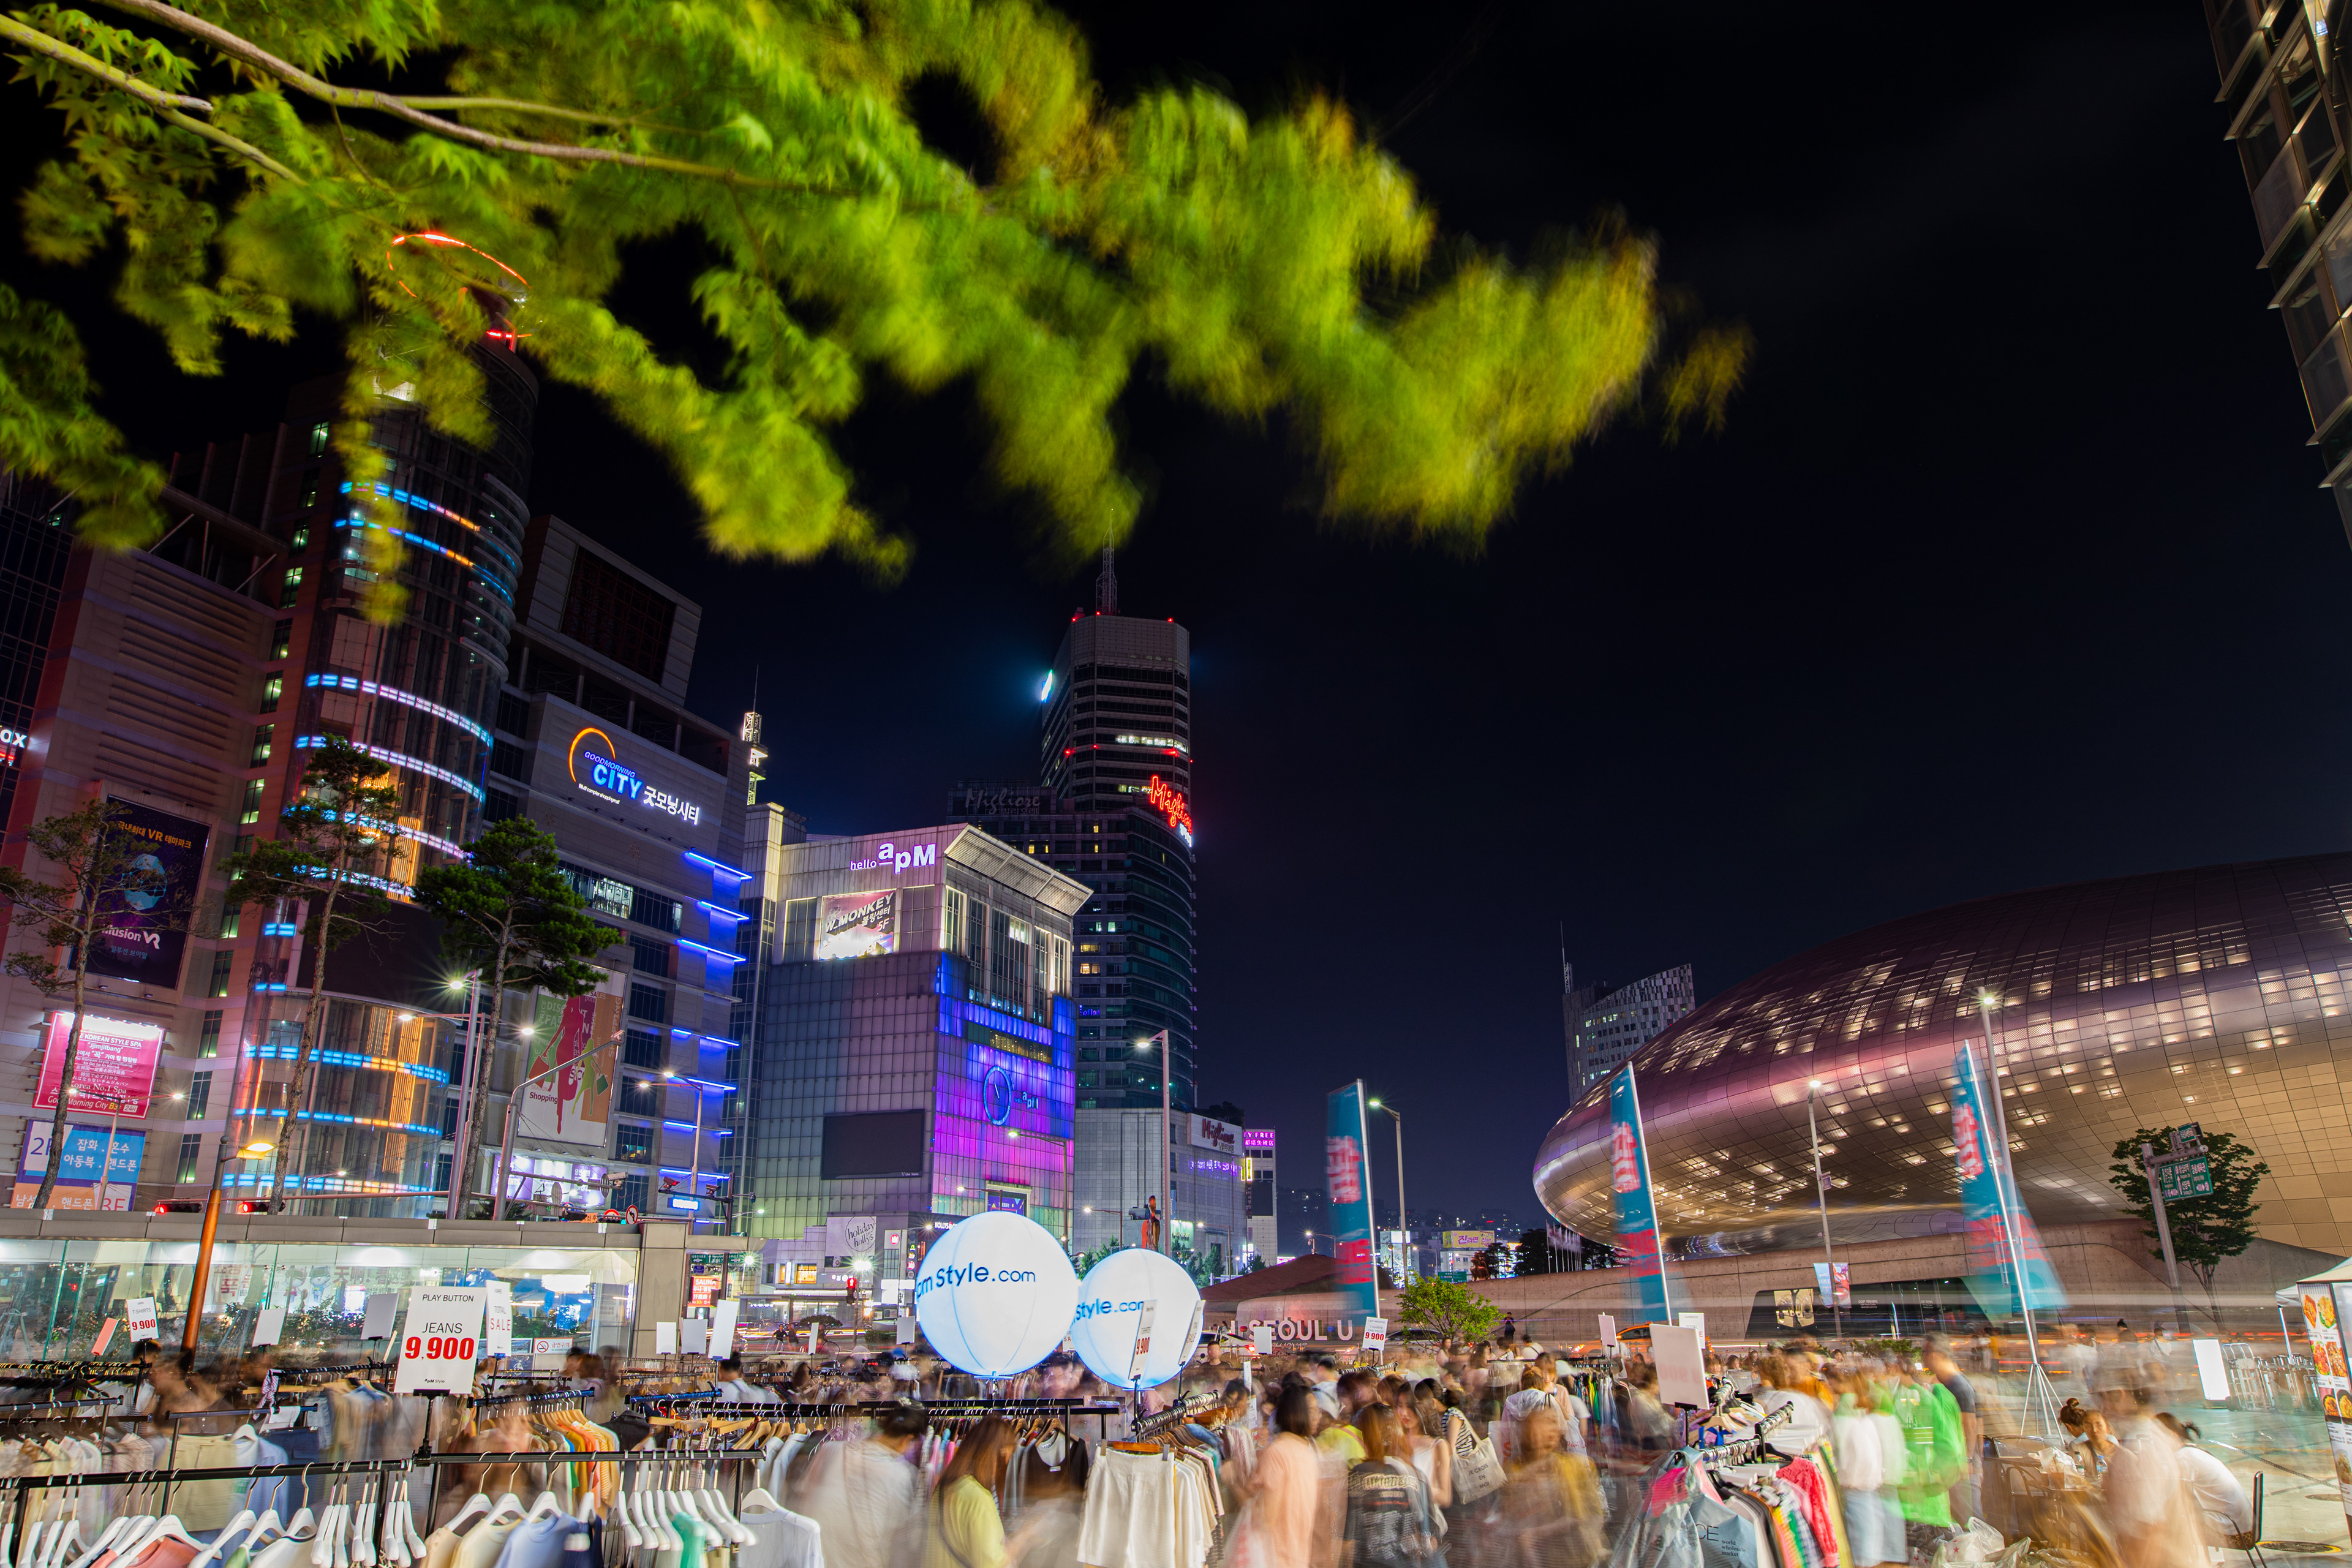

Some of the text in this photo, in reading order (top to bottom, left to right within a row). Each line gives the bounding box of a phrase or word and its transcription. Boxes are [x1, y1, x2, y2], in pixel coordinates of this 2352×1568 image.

[584, 751, 636, 778] GOODMORNING
[593, 764, 642, 799] CITY
[643, 785, 700, 826] 굿모닝시티
[965, 788, 1041, 815] Migliore
[148, 829, 163, 842] VR
[164, 835, 192, 849] 테마파크
[850, 842, 936, 875] hello apM
[825, 892, 895, 933] W_MONKEY
[861, 905, 891, 927] 볼링센터
[877, 918, 890, 932] 5F
[143, 931, 160, 949] VR
[111, 945, 148, 959] 일루션 브이알
[85, 1033, 109, 1042] KOREAN
[93, 1083, 111, 1091] No.1
[95, 1101, 108, 1110] City
[529, 1091, 558, 1104] Shopping
[77, 1139, 98, 1151] 잡화
[64, 1155, 137, 1171] 아동복 핸드폰
[847, 1222, 875, 1240] holiday
[853, 1234, 874, 1248] hollys
[1458, 1235, 1479, 1245] 진라면
[422, 1322, 462, 1333] JEANS
[490, 1318, 511, 1331] SALE
[1249, 1319, 1328, 1341] SEOUL
[1337, 1319, 1353, 1341] U
[405, 1336, 475, 1361] 9,900
[1474, 1463, 1488, 1473] CROIS
